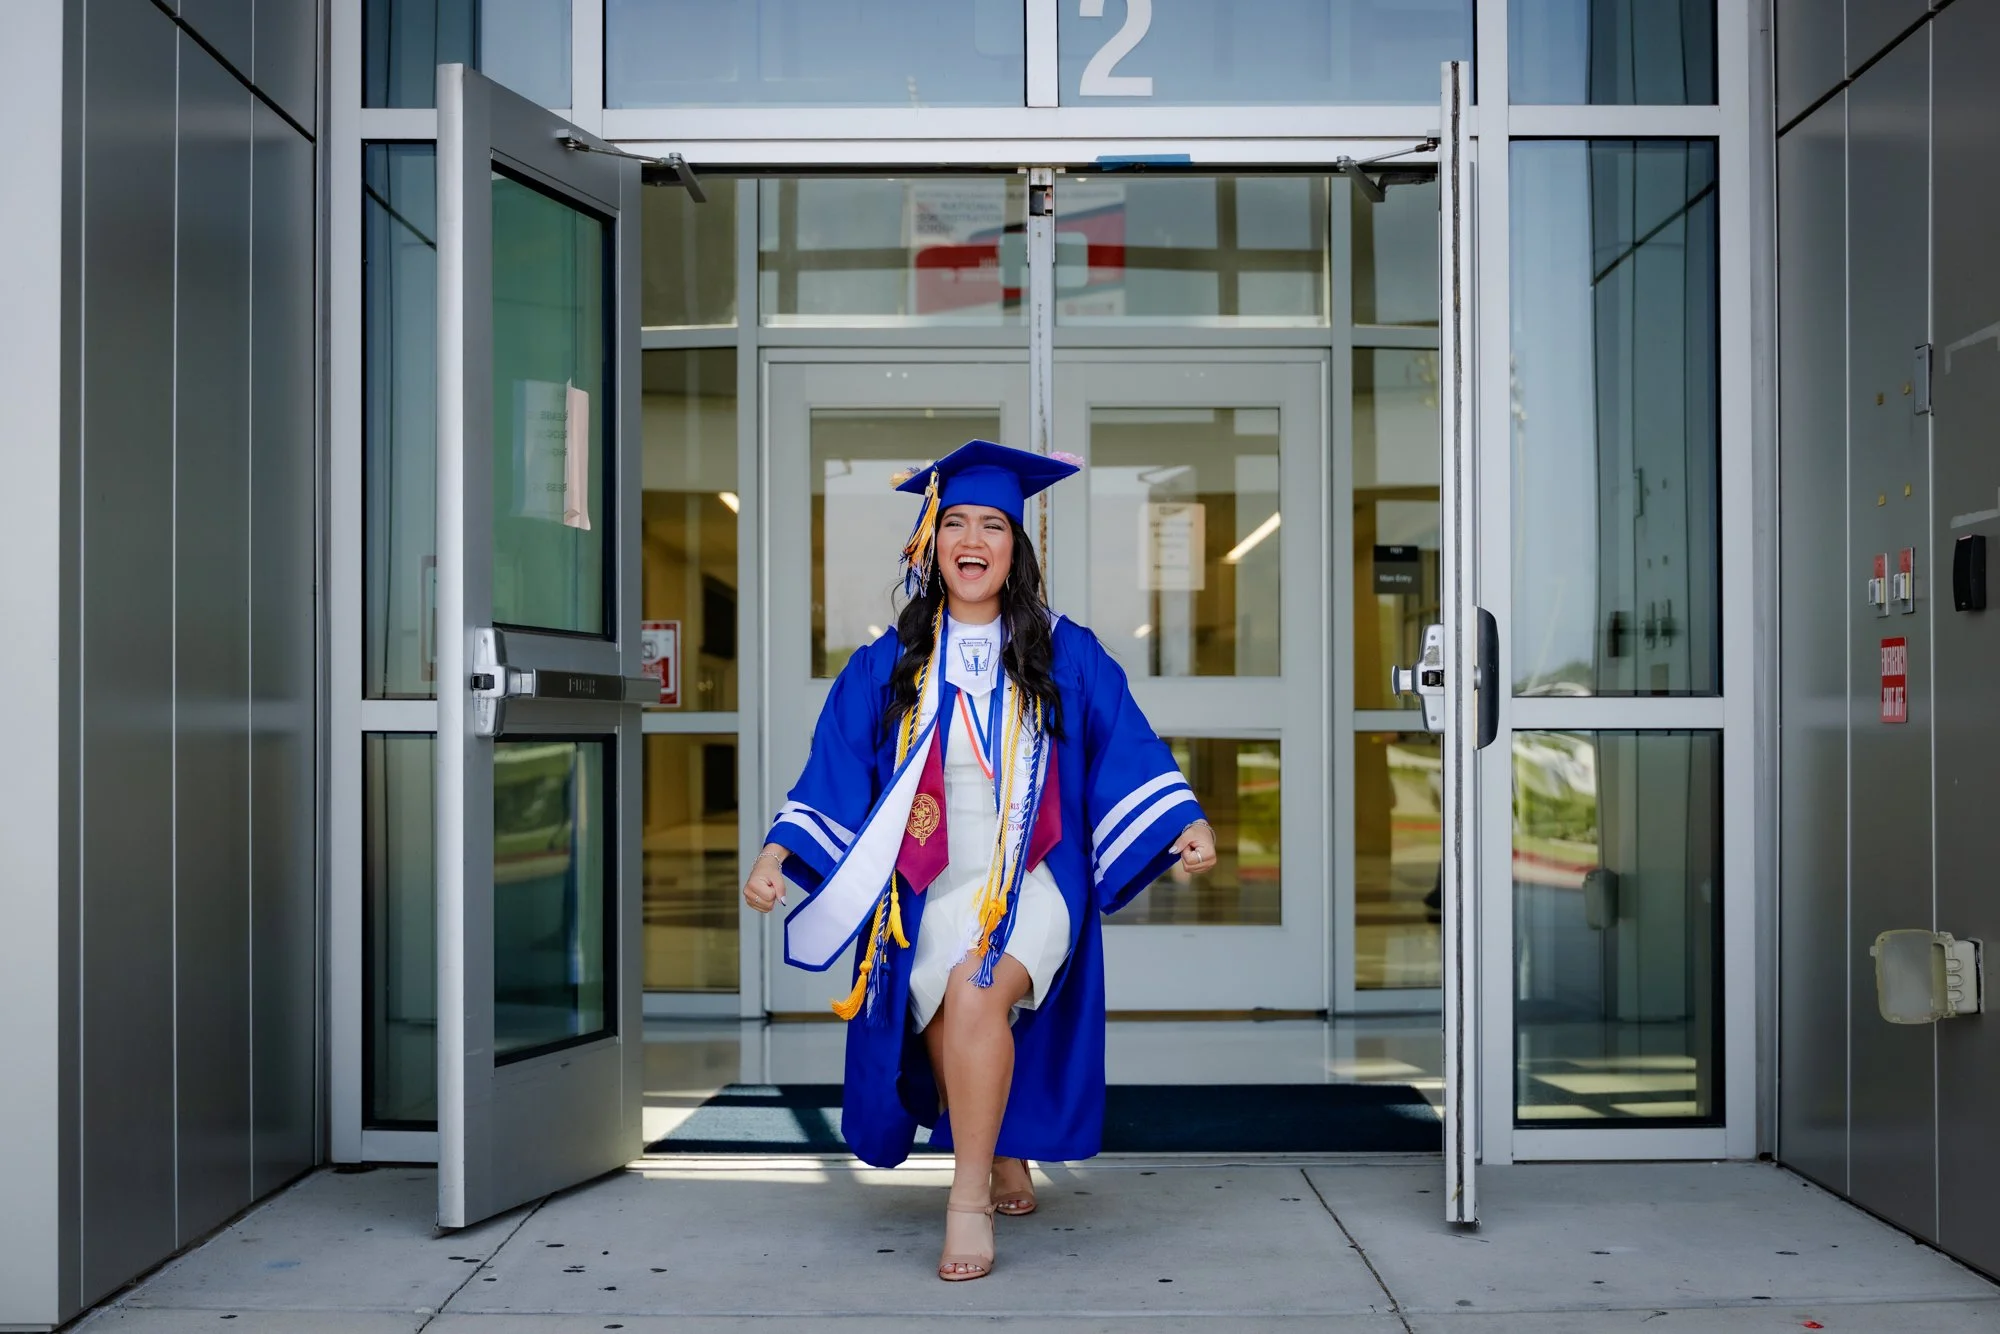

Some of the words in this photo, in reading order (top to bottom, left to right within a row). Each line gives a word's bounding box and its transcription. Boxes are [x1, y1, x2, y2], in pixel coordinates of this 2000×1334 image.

[1079, 0, 1153, 96] 2
[1881, 646, 1906, 676] EMERGENCY
[1895, 686, 1904, 717] OFF
